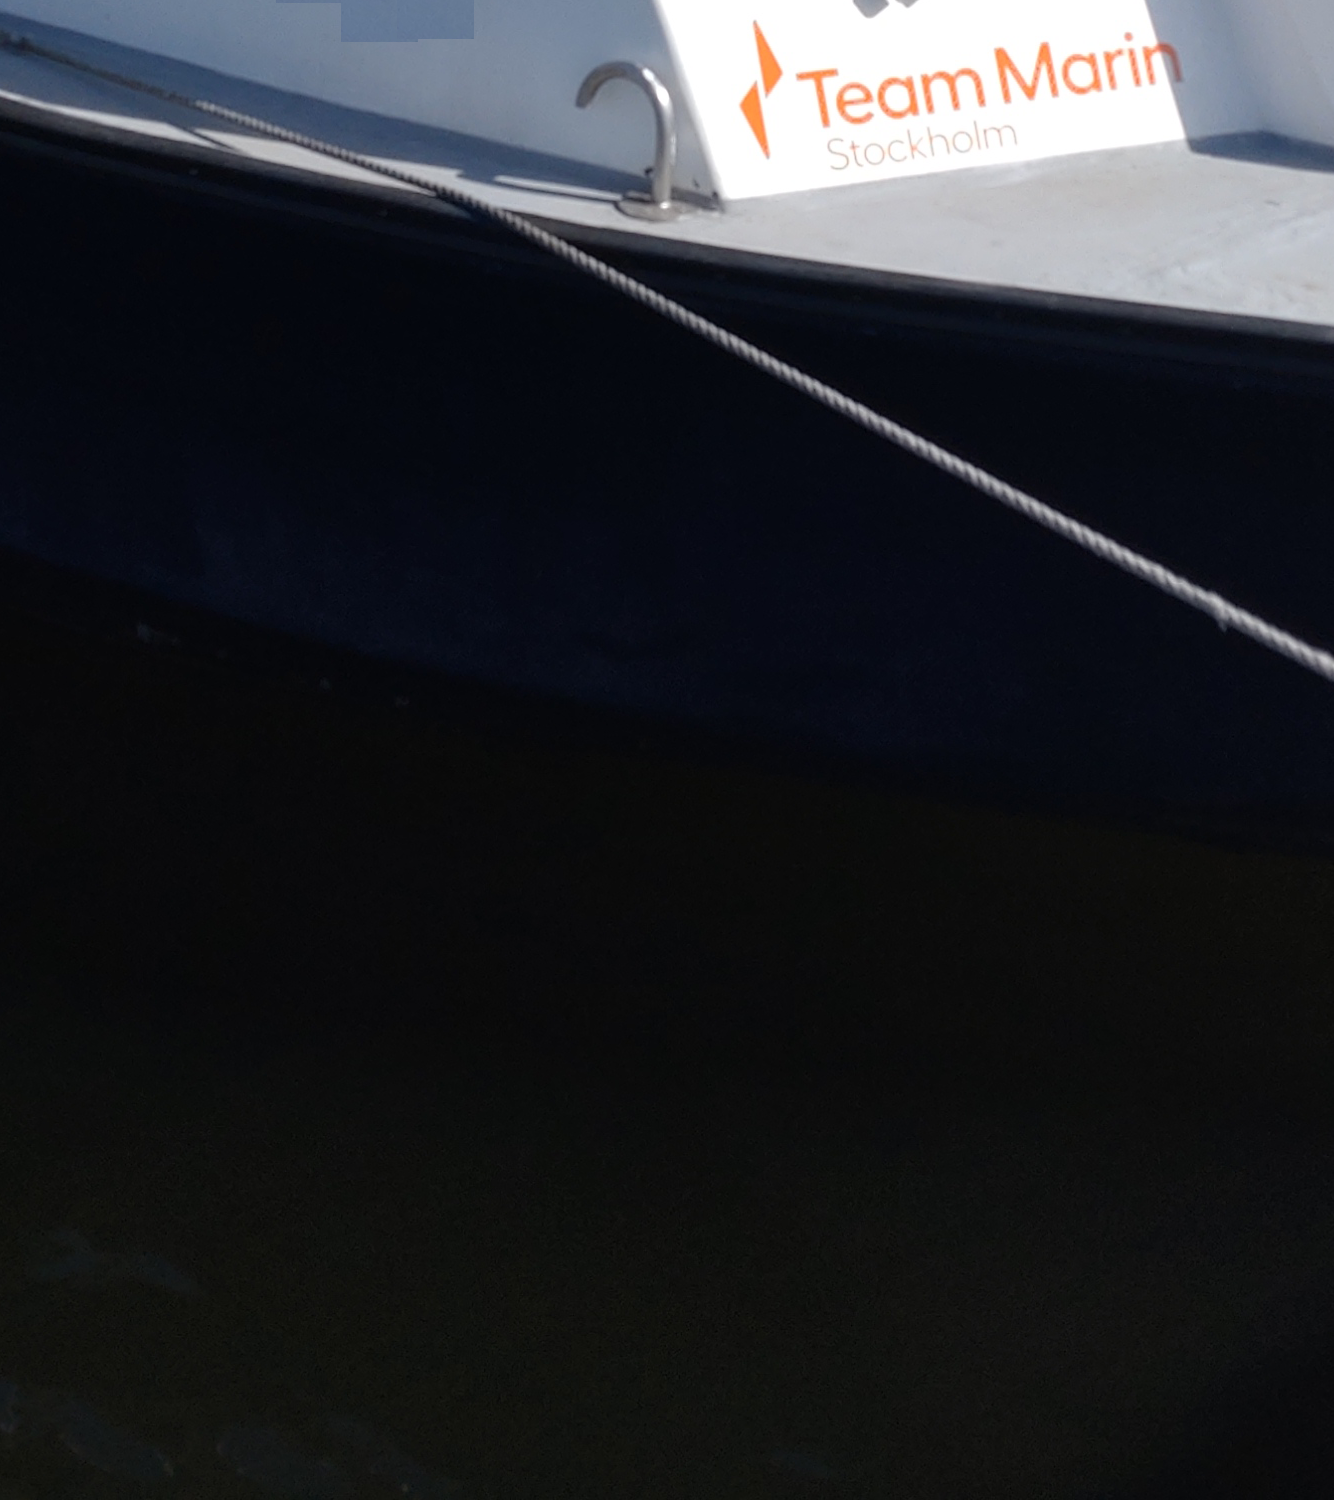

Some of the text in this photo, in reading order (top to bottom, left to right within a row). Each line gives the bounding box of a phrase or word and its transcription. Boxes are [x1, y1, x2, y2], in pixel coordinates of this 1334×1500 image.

[796, 32, 1184, 129] Team Marin
[827, 120, 1018, 171] Stockholm
